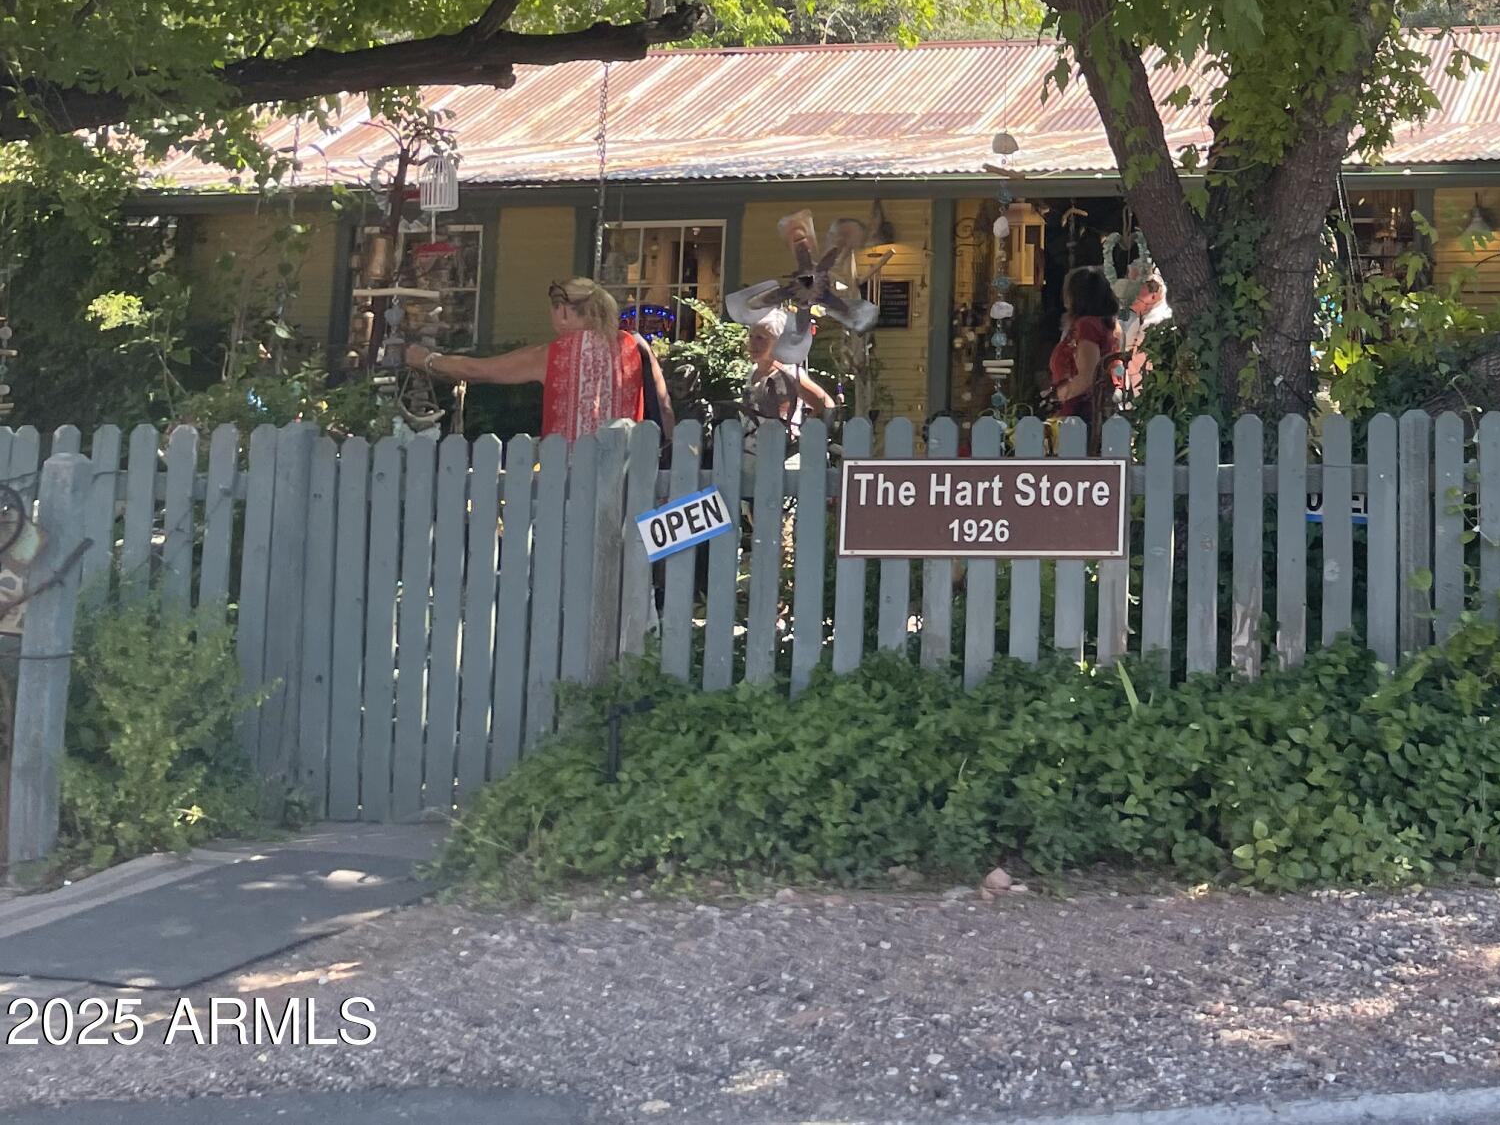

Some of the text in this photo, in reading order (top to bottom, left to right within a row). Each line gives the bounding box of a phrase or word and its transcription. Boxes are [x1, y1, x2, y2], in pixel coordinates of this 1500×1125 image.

[853, 472, 1111, 507] The Hart Store
[650, 494, 724, 548] OPEN
[948, 518, 1011, 543] 1926
